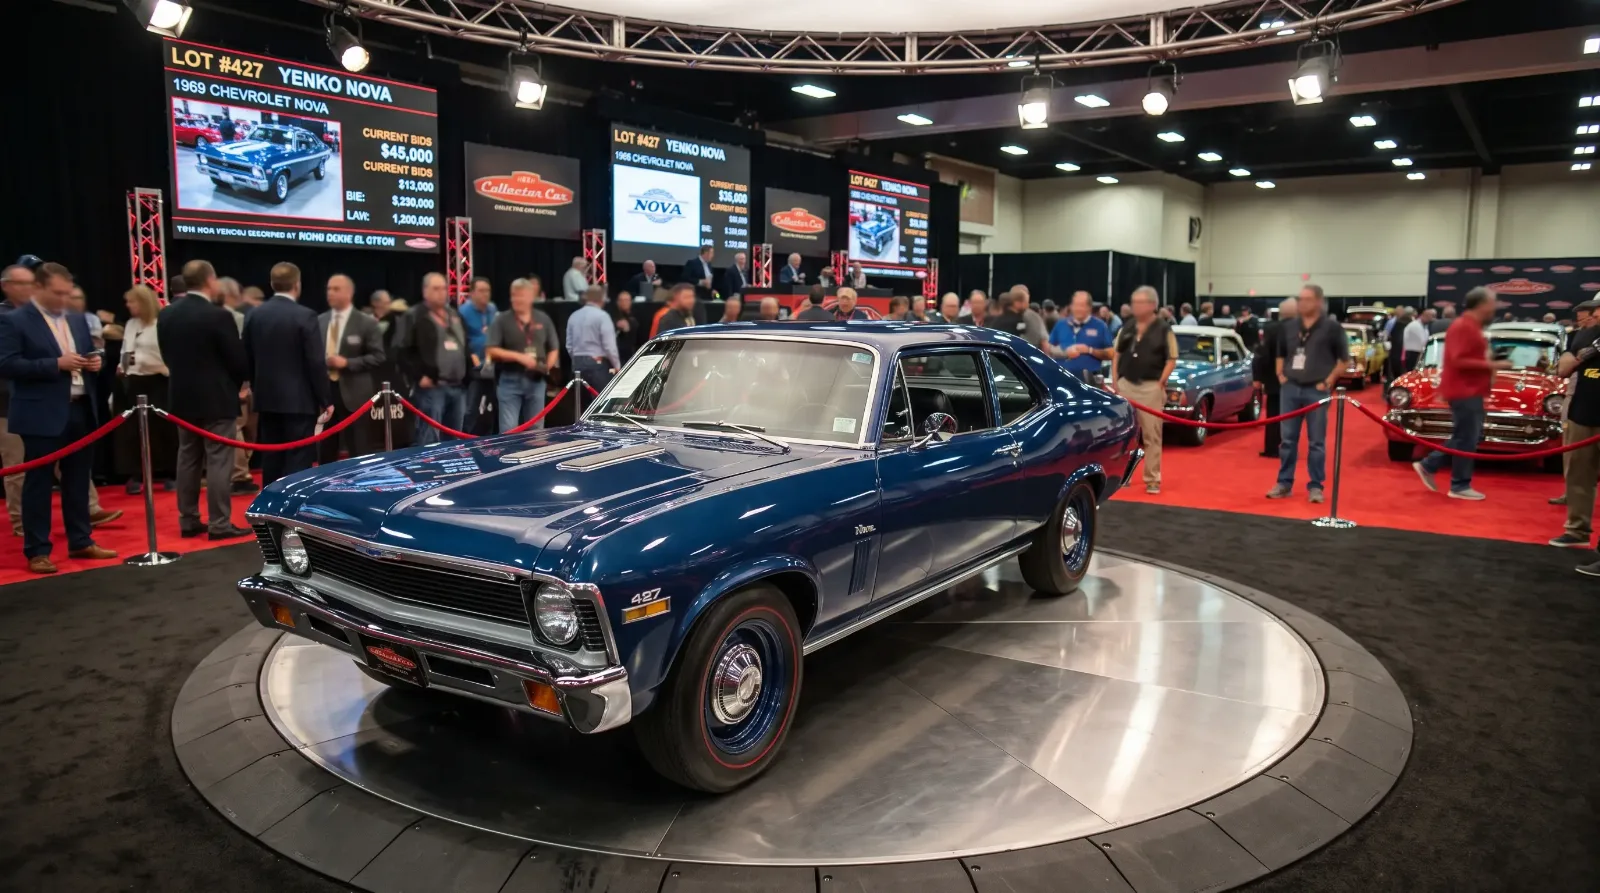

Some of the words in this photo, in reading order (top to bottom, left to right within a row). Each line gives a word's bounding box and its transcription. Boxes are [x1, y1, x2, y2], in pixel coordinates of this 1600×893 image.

[171, 47, 214, 70] LOT
[219, 56, 264, 79] #427
[278, 66, 342, 93] YENKO
[346, 80, 393, 102] NOVA
[173, 78, 207, 95] 1969
[209, 84, 291, 108] CHEVROLET
[294, 98, 329, 114] NOVA
[362, 127, 410, 143] CURRENT
[410, 134, 433, 147] BIDS
[614, 129, 636, 145] LOT
[636, 134, 661, 149] #427
[380, 143, 433, 164] $45,000
[666, 138, 700, 157] YENKO
[700, 145, 726, 161] NOVA
[363, 160, 409, 175] CURRENT
[410, 166, 433, 178] BIDS
[632, 153, 675, 169] CHEVROLET
[675, 160, 694, 171] NOVA
[544, 188, 569, 202] Car
[634, 199, 682, 215] NOVA
[391, 212, 435, 227] 1,200,000
[631, 587, 662, 604] 427
